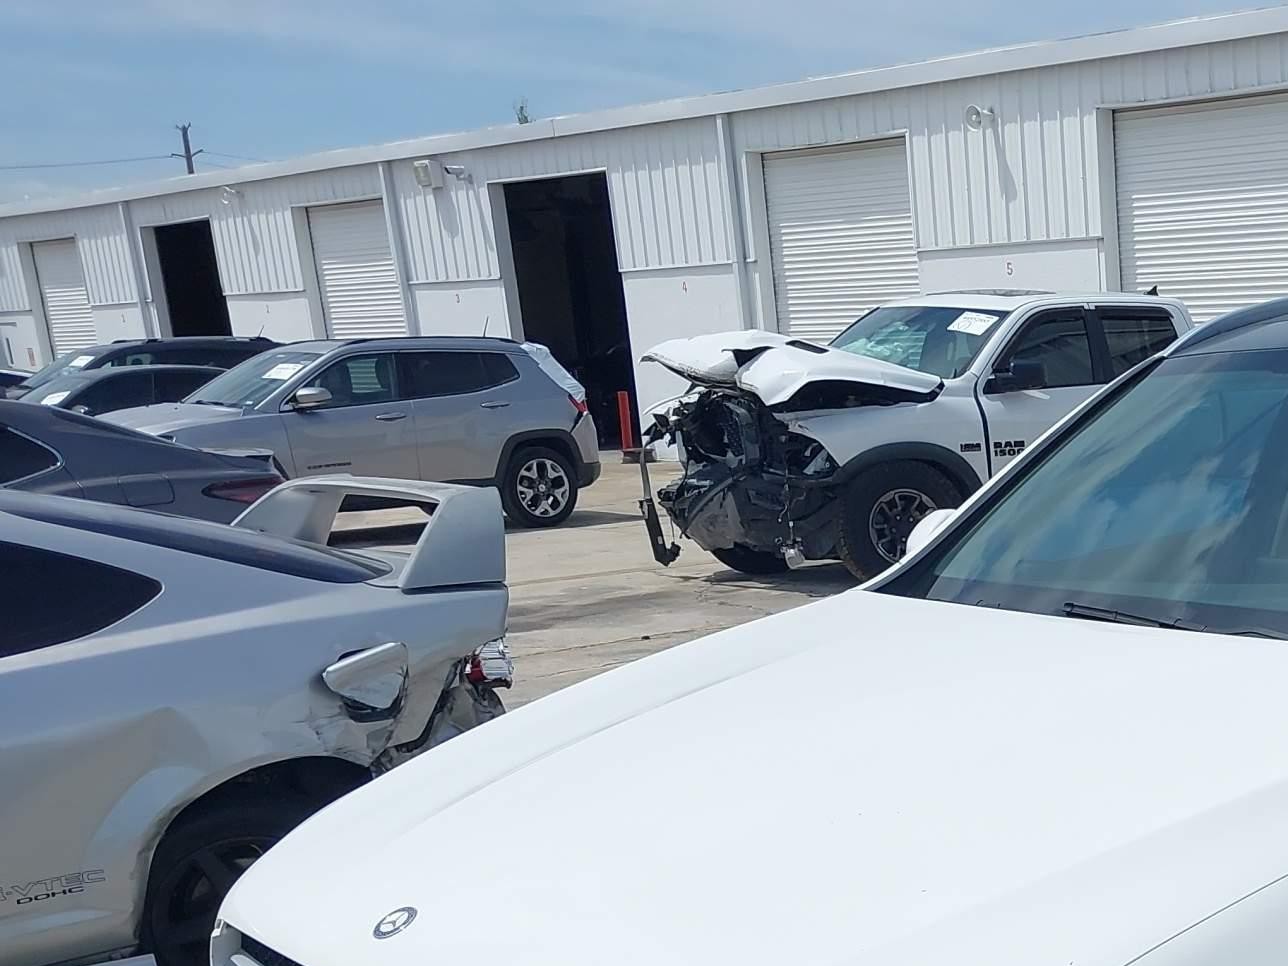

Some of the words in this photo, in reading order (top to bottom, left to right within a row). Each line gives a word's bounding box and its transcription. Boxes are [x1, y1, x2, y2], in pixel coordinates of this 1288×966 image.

[1006, 262, 1013, 276] 5
[682, 281, 688, 293] 4
[17, 886, 84, 904] DOHC
